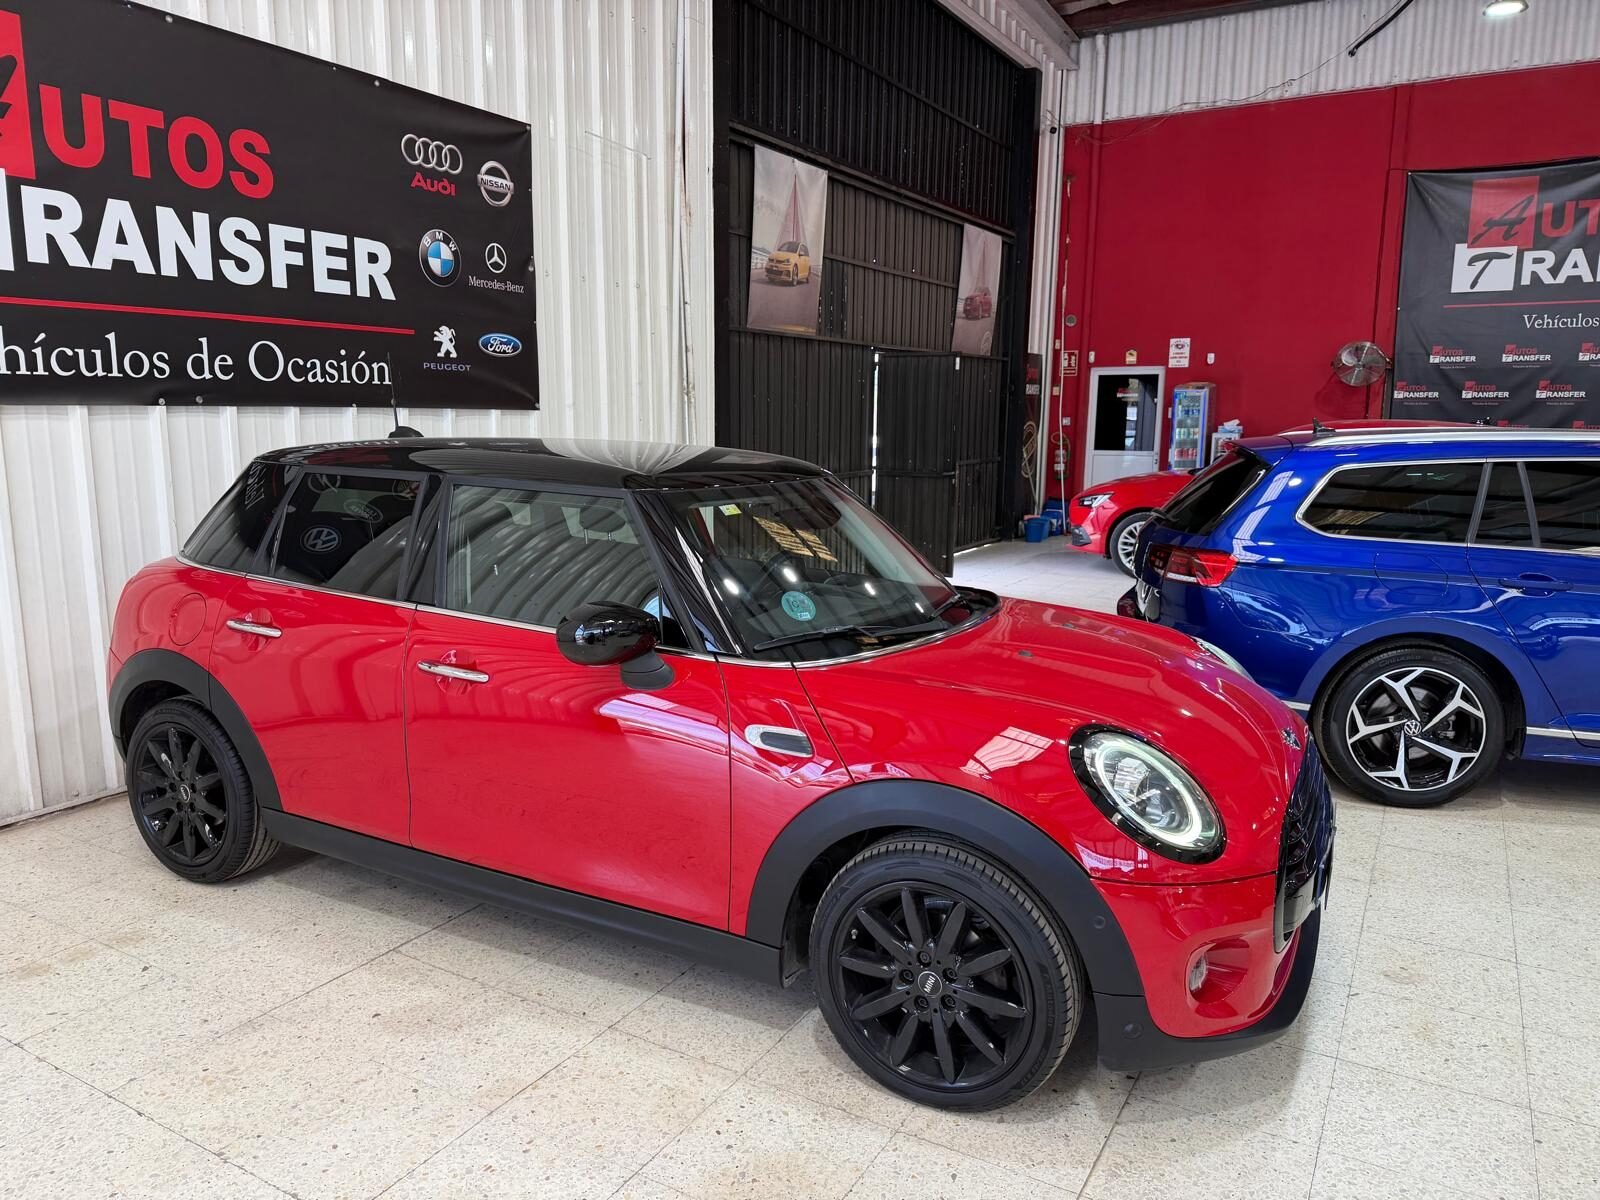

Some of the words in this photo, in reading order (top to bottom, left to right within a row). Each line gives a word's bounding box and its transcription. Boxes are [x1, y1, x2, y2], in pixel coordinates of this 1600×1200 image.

[411, 172, 456, 196] Audi
[480, 177, 512, 191] NISSAN
[20, 184, 396, 300] RANSFER
[423, 231, 457, 252] BMW
[1462, 247, 1600, 291] TRA
[468, 275, 524, 293] Mercedes-Benz
[1523, 313, 1600, 329] Vehículos
[487, 336, 514, 354] Ford
[0, 325, 171, 379] hículos
[186, 337, 235, 381] de
[249, 340, 392, 385] Ocasión
[423, 362, 471, 372] PEUGEOT
[923, 975, 936, 994] MINI
